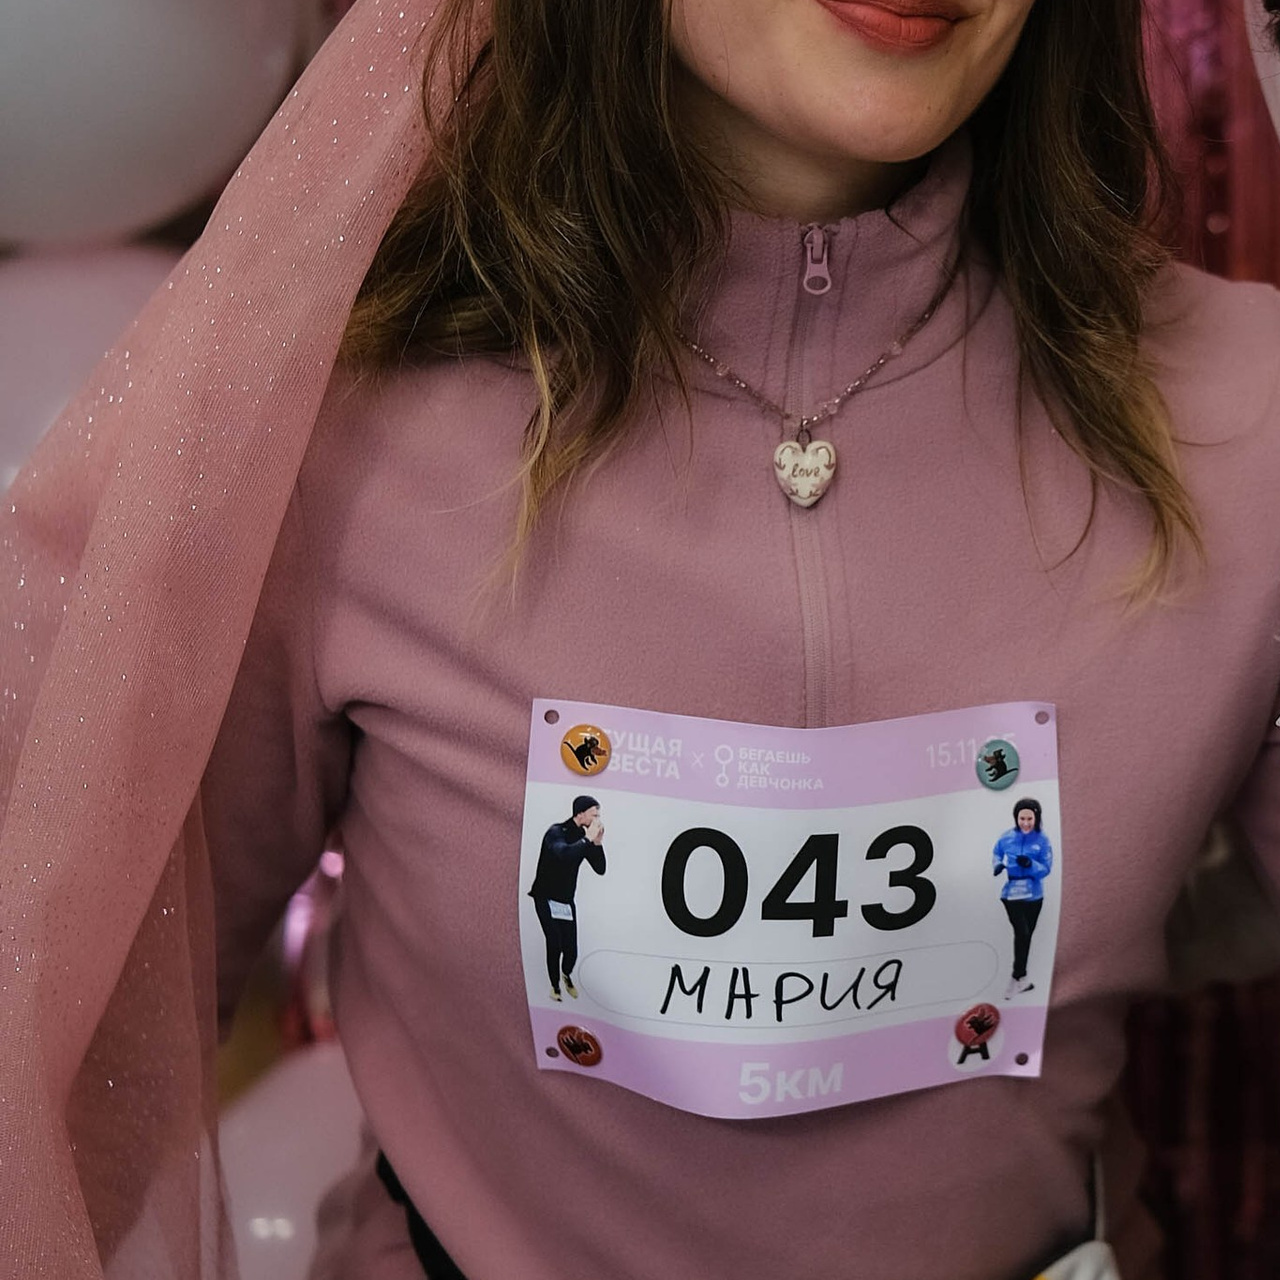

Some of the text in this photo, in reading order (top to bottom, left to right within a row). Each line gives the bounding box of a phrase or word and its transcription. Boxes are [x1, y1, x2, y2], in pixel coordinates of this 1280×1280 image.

[791, 464, 820, 477] love
[606, 729, 683, 758] УЩАЯ
[738, 747, 812, 765] БЕГАЕШЬ
[609, 756, 681, 781] ВЕСТА
[738, 762, 770, 776] КАК
[736, 775, 824, 791] ДЕВЧОНКА
[661, 824, 938, 938] 043
